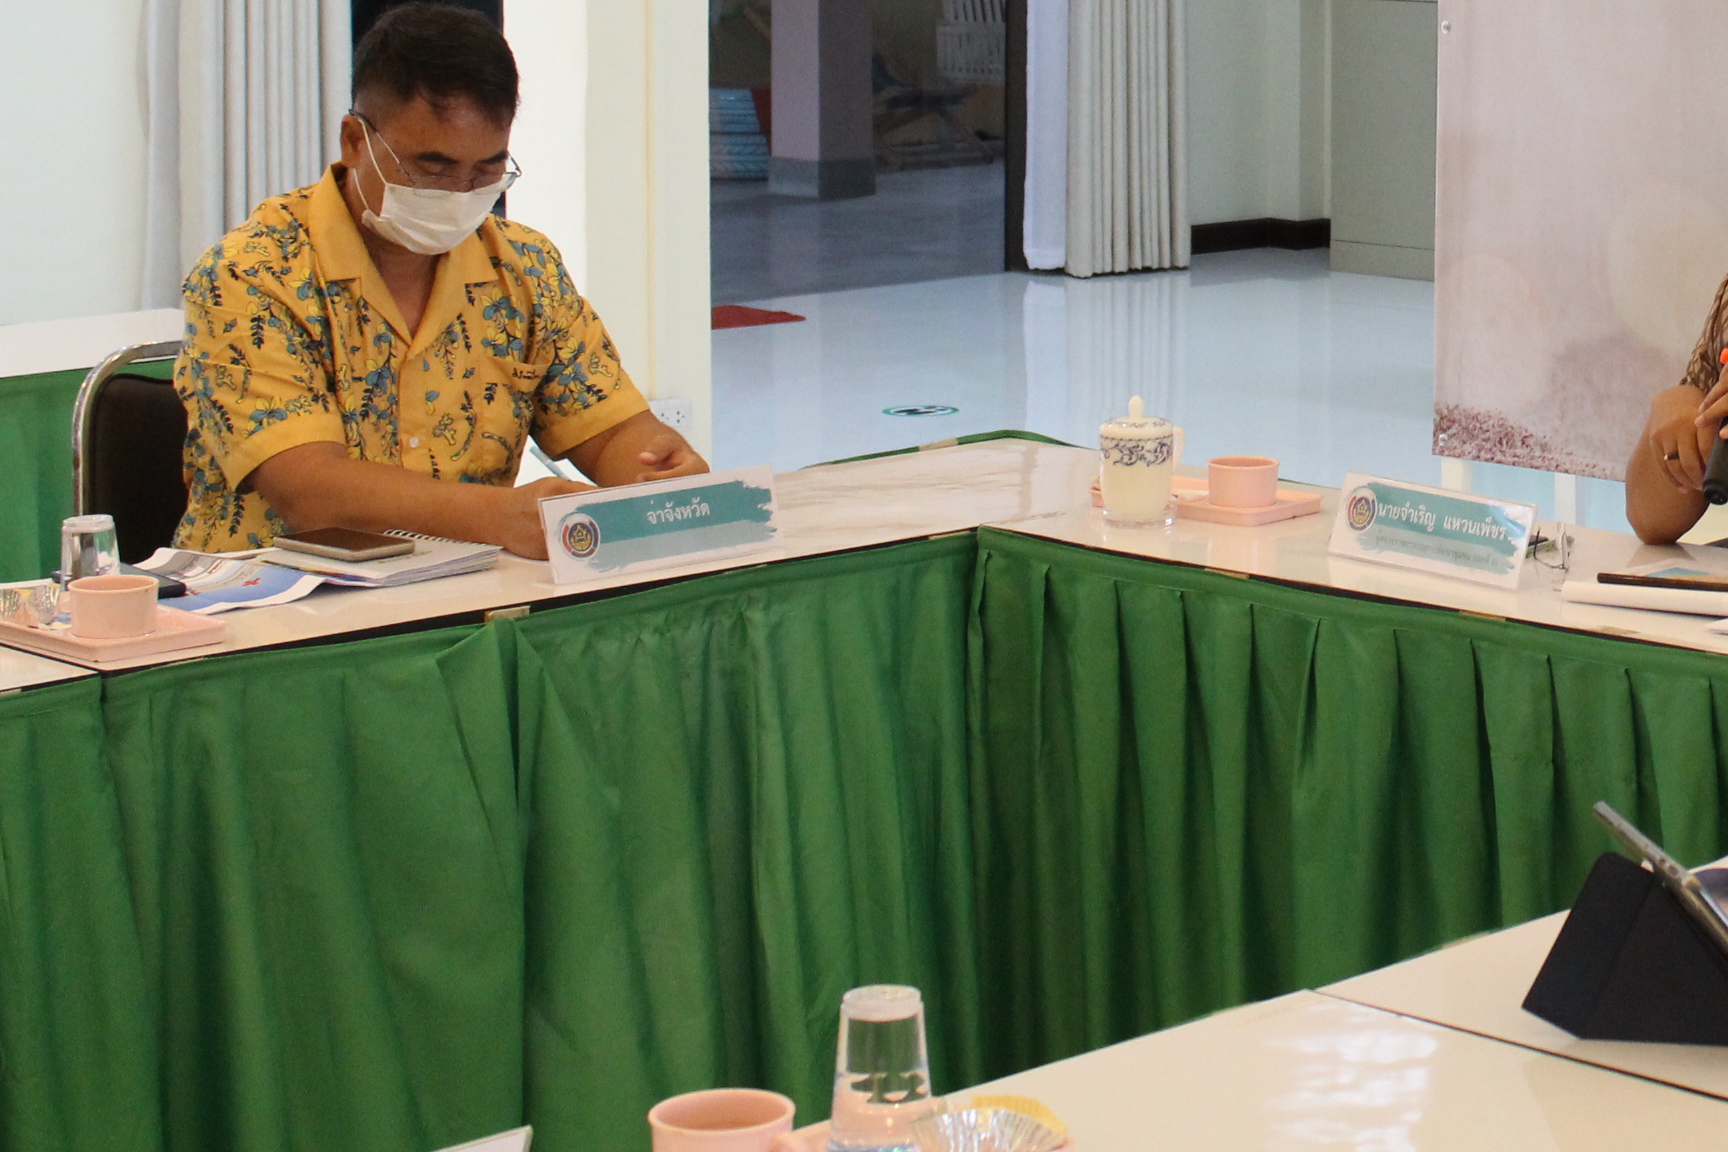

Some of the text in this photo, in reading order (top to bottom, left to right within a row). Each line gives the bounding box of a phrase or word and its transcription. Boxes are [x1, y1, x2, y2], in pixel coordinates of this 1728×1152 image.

[646, 496, 710, 524] จ่าจังหวัด
[1378, 501, 1436, 532] นายจำเริญ
